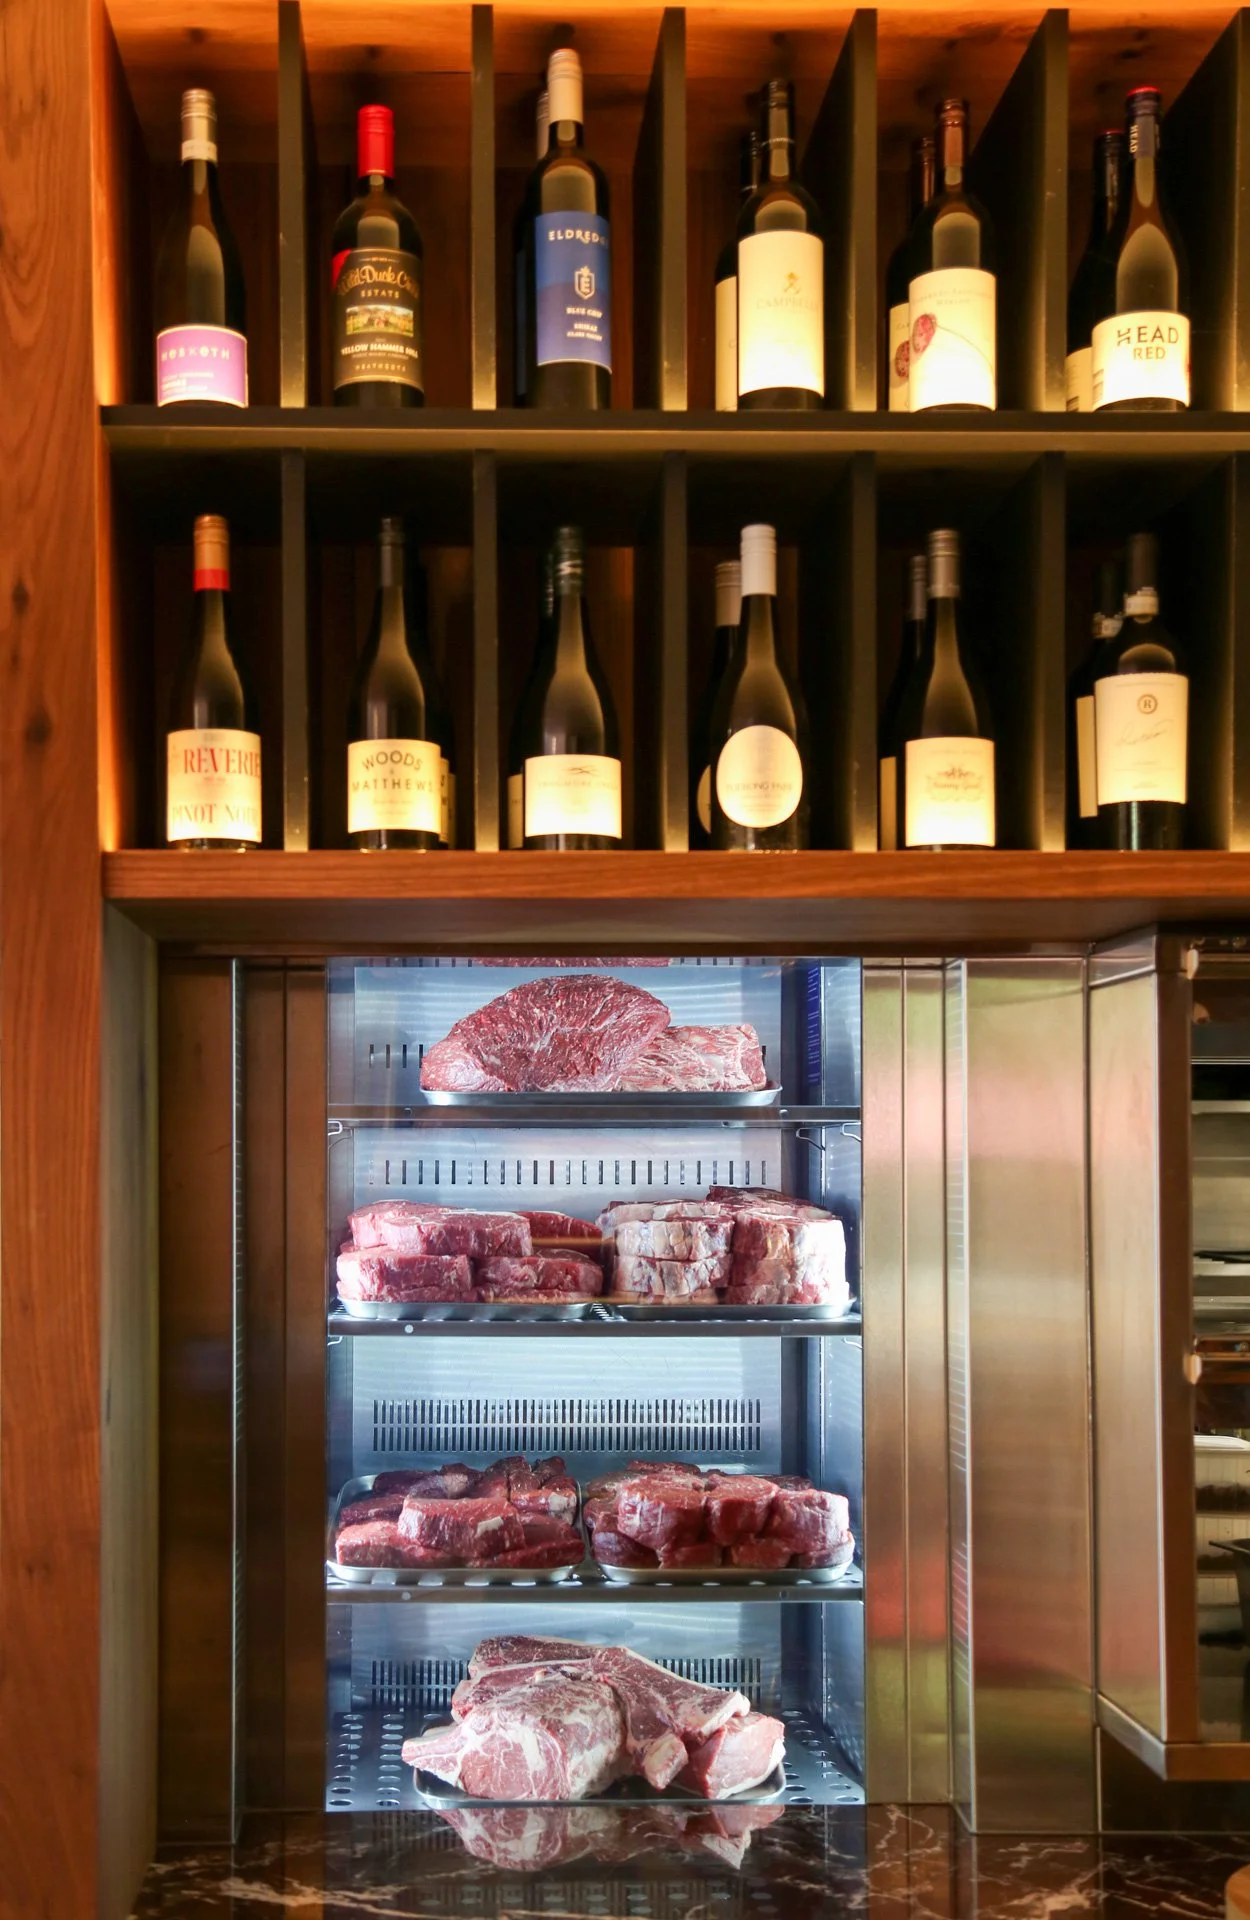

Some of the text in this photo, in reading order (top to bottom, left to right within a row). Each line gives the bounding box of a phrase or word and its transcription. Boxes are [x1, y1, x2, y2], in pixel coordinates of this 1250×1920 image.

[548, 229, 608, 246] ELDRED
[1117, 325, 1179, 347] HEAD
[1133, 346, 1166, 360] RED
[184, 747, 260, 779] REVERIE
[362, 750, 423, 771] WOODS
